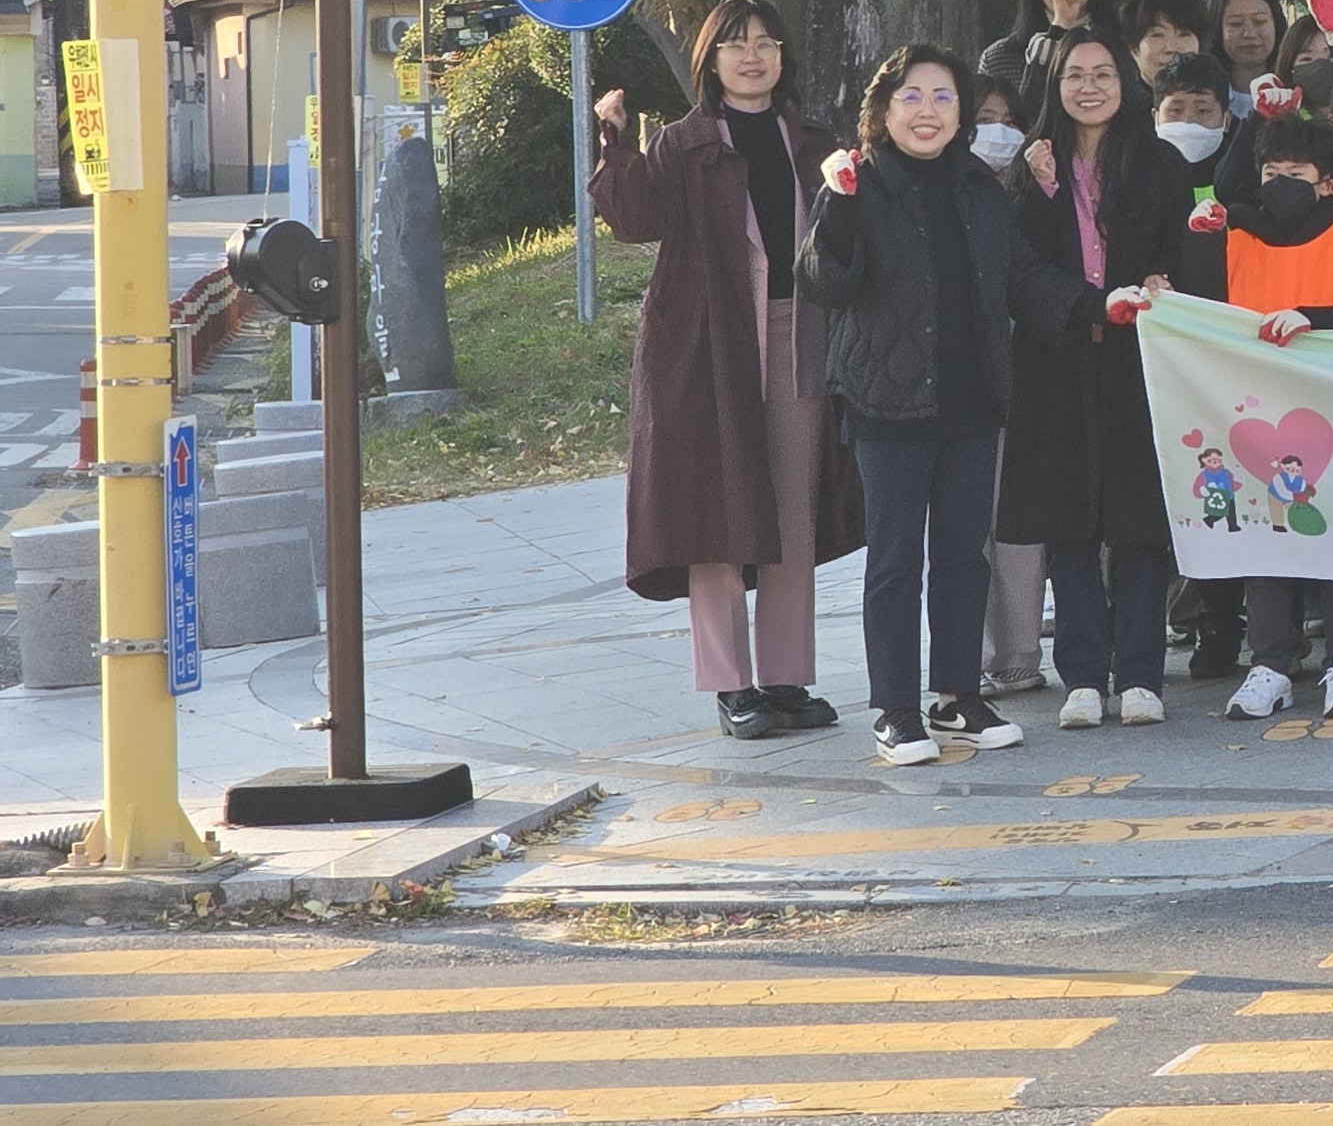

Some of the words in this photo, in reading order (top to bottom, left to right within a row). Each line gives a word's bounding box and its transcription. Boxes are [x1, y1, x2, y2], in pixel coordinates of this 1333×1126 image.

[71, 73, 100, 103] 일시
[75, 107, 104, 138] 정지
[172, 495, 184, 571] 신호가
[184, 494, 195, 577] 버튼을
[174, 578, 186, 678] 바뀝니다
[185, 591, 197, 674] 누르면
